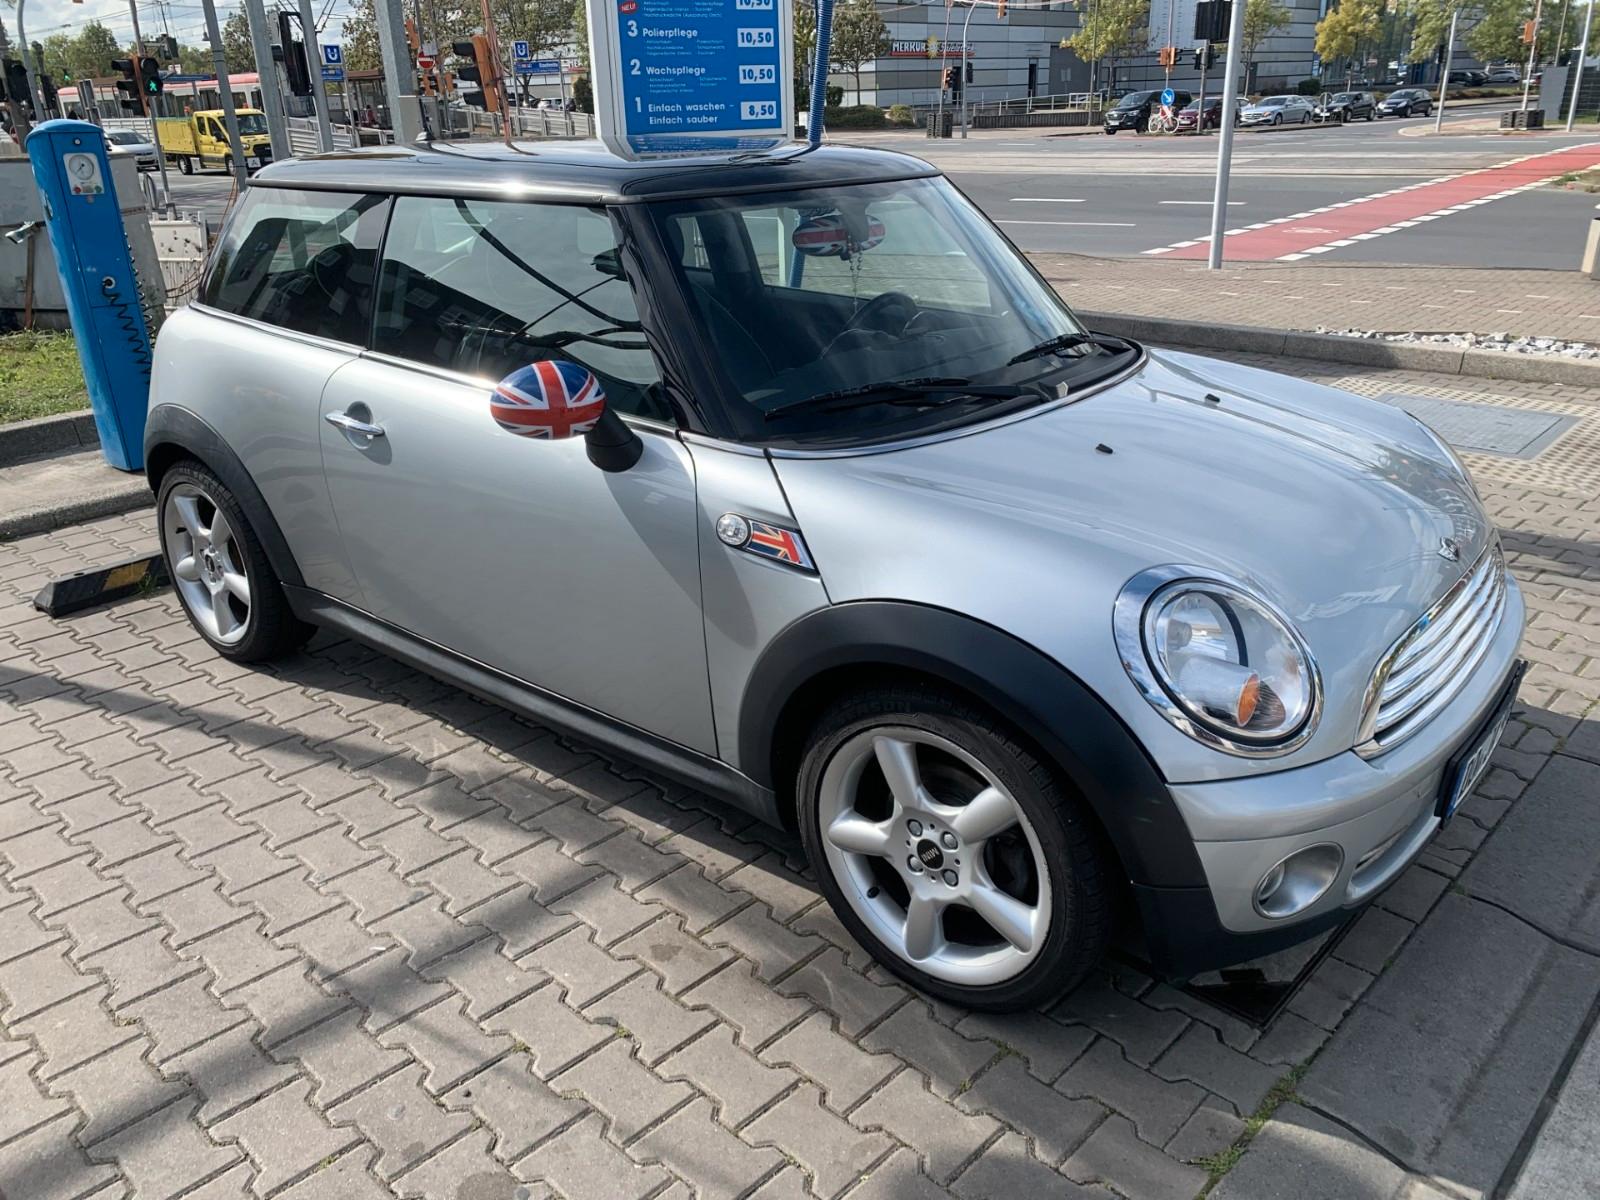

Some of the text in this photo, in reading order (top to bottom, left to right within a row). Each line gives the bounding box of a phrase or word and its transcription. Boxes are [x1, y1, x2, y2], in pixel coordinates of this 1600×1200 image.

[627, 20, 698, 39] 3 Polierpflege
[740, 31, 772, 45] 10,50
[892, 41, 926, 52] MERKUR
[630, 58, 706, 76] 2 Wachspflege
[741, 68, 773, 82] 10,50
[634, 96, 642, 113] 1
[648, 103, 682, 113] Einfach
[686, 102, 725, 111] waschen
[748, 104, 774, 118] 8,50
[649, 115, 719, 125] Einfach sauber
